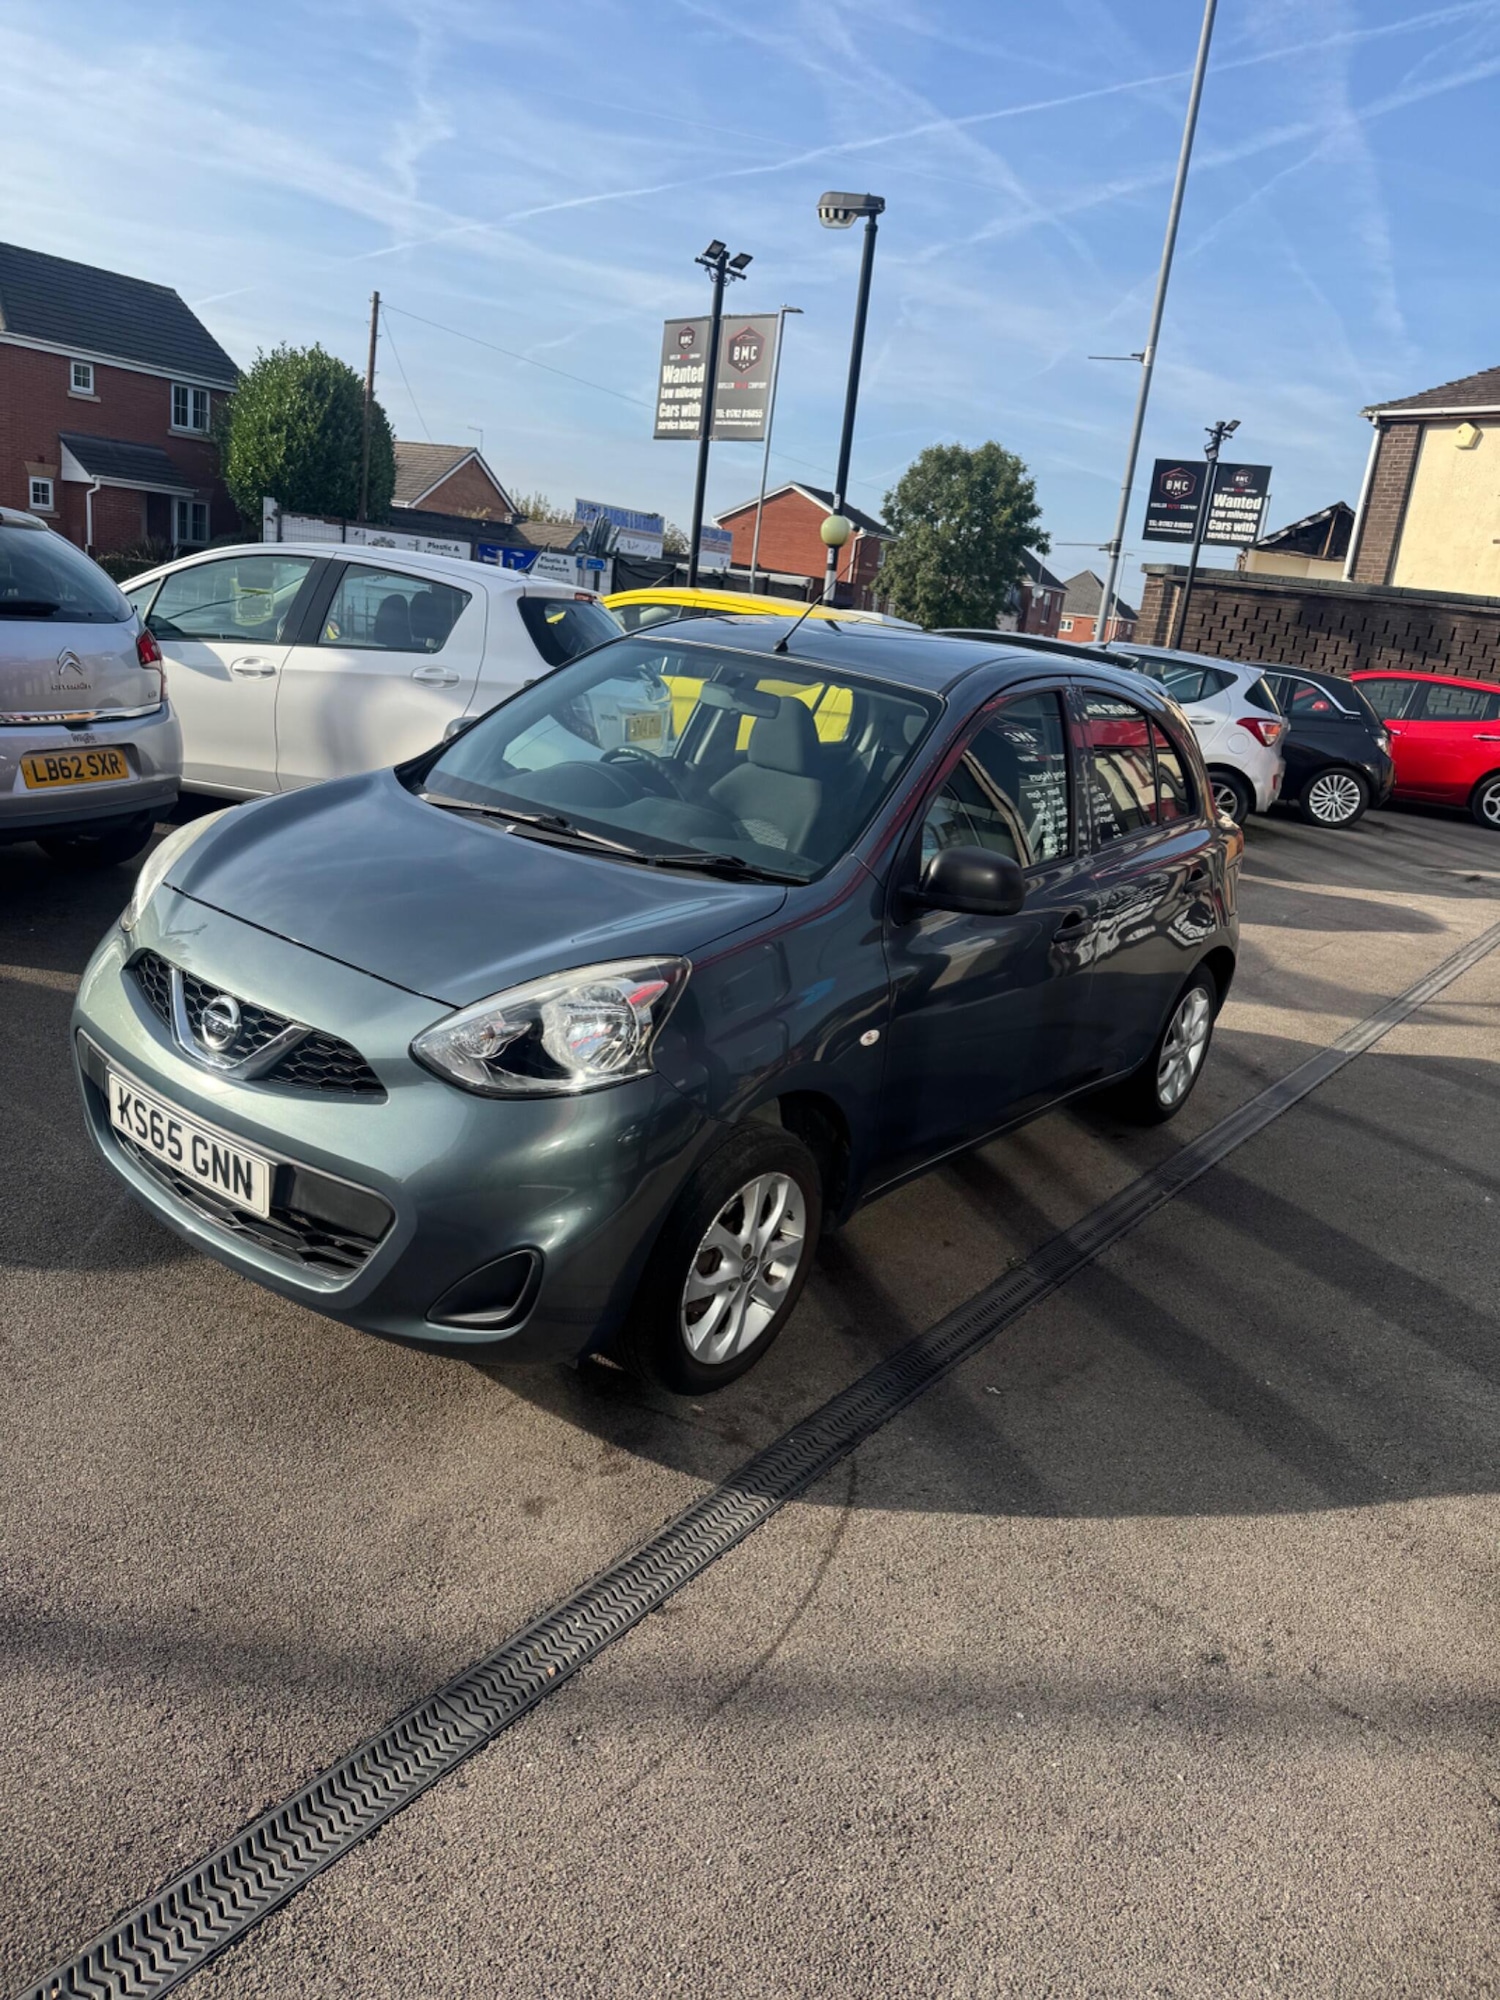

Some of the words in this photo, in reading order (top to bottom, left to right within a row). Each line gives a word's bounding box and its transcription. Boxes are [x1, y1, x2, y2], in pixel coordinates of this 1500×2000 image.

[733, 346, 758, 360] BMC
[663, 363, 705, 383] Wanted
[660, 388, 674, 398] Low
[675, 387, 702, 400] mileage
[658, 402, 680, 418] Cars
[680, 402, 700, 417] with
[658, 421, 678, 430] service
[679, 420, 700, 430] history
[1166, 480, 1189, 492] BMC
[1213, 494, 1262, 510] Wanted
[1211, 508, 1226, 518] Low
[1226, 509, 1258, 521] mileage
[1208, 520, 1232, 532] Cars
[1234, 521, 1256, 533] with
[1230, 534, 1254, 542] history
[427, 541, 452, 552] Plastic
[540, 556, 561, 566] Plastic
[537, 564, 570, 573] Hardware
[30, 756, 85, 783] LB62
[86, 752, 122, 779] SXR
[117, 1087, 182, 1162] KS65
[192, 1135, 252, 1202] GNN
